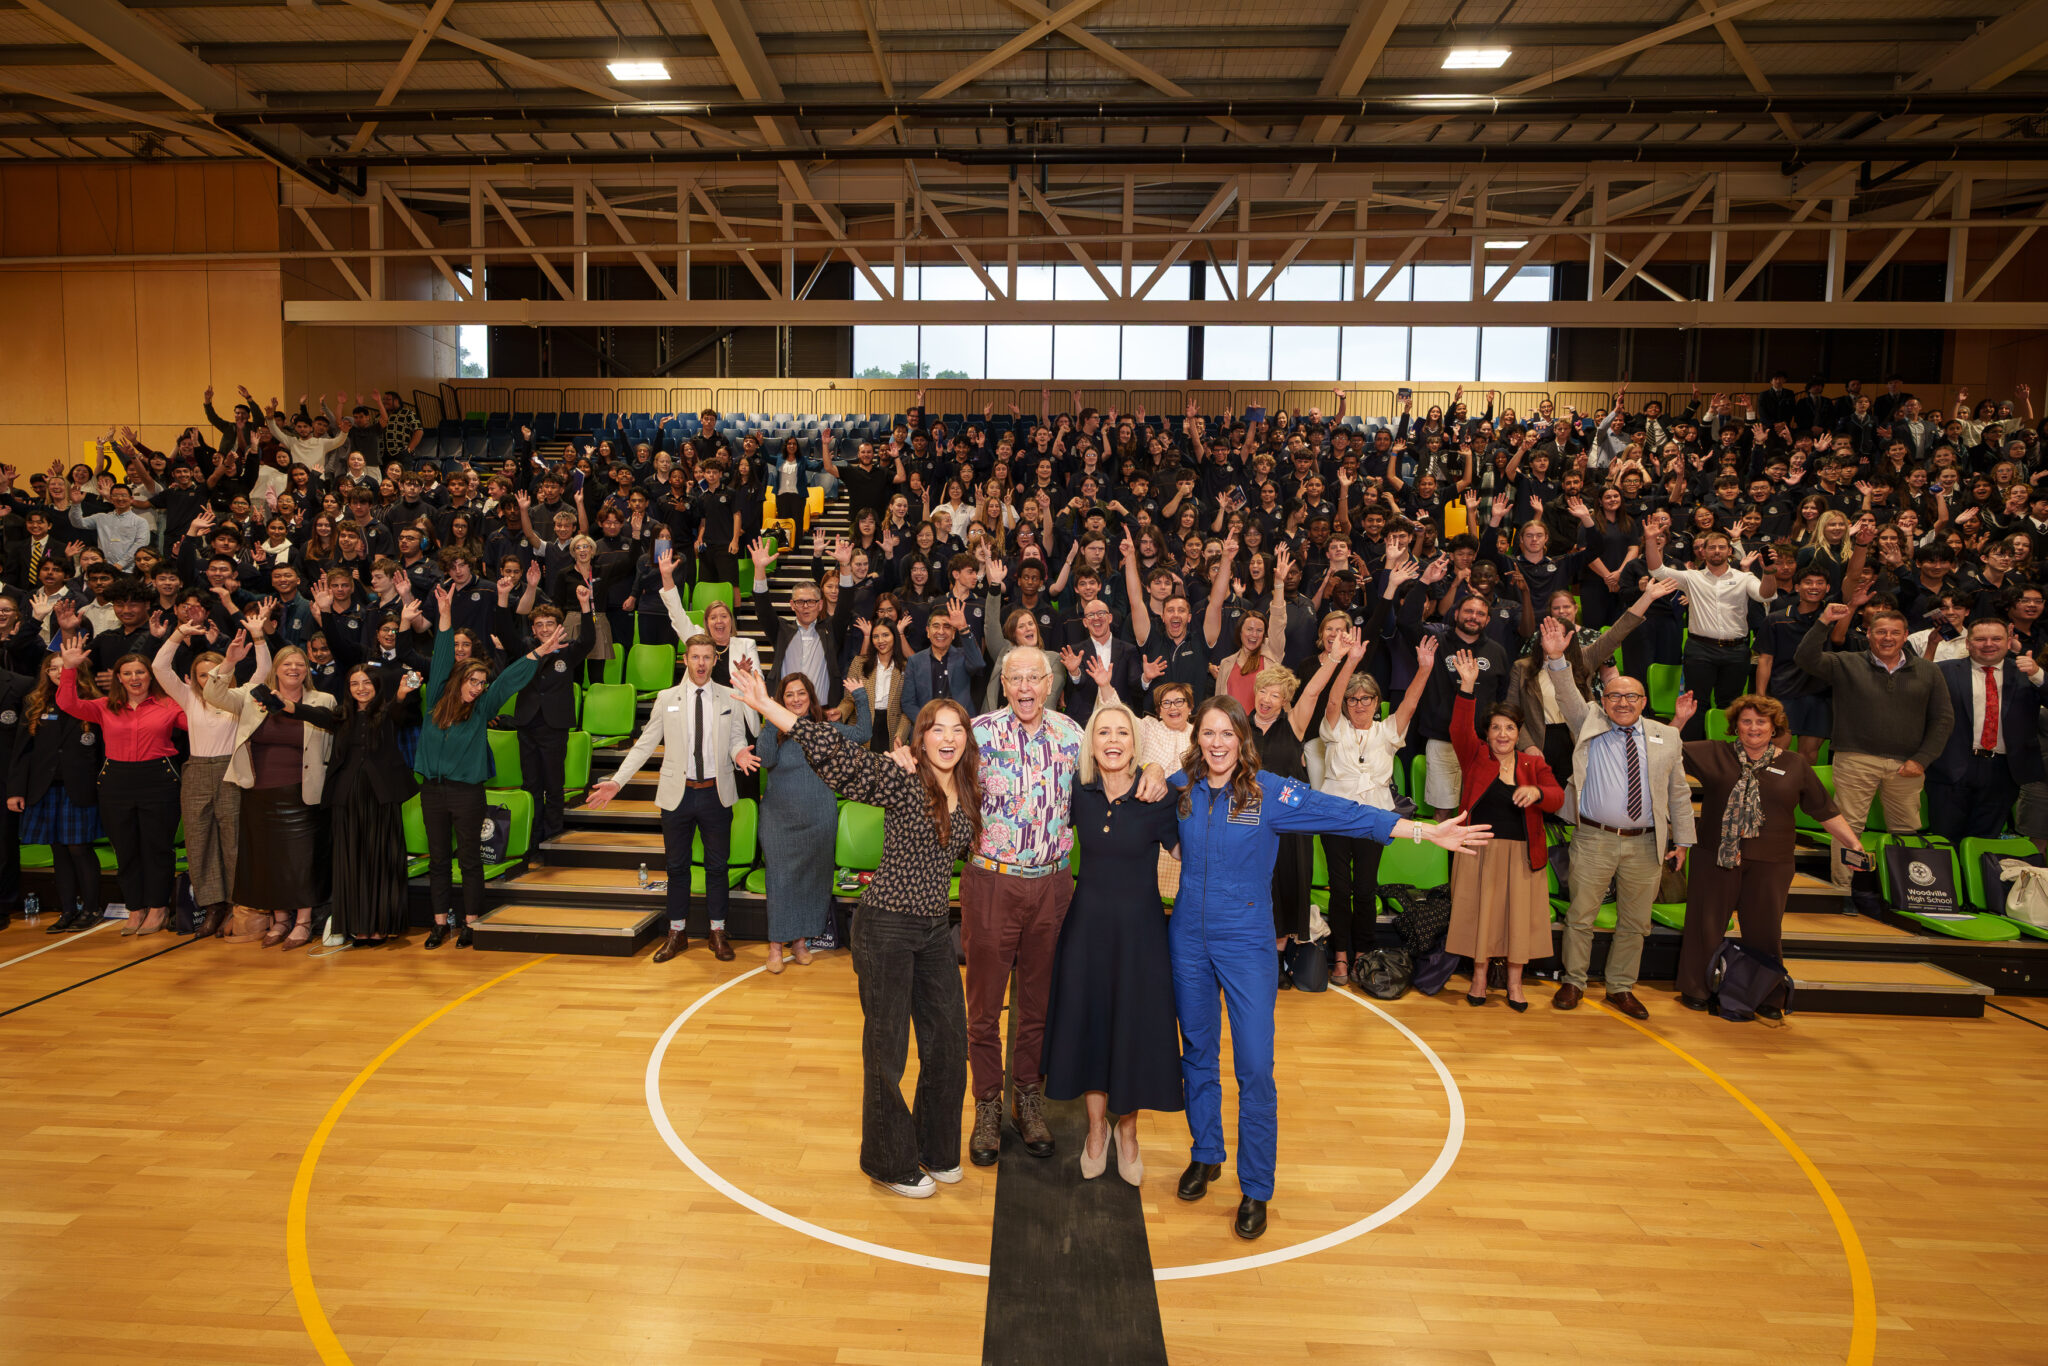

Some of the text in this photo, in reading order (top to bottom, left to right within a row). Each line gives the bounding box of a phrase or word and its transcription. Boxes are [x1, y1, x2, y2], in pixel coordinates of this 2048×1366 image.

[480, 852, 497, 860] chool
[1907, 888, 1948, 897] Woodville
[1906, 895, 1953, 905] High School
[812, 940, 835, 948] School
